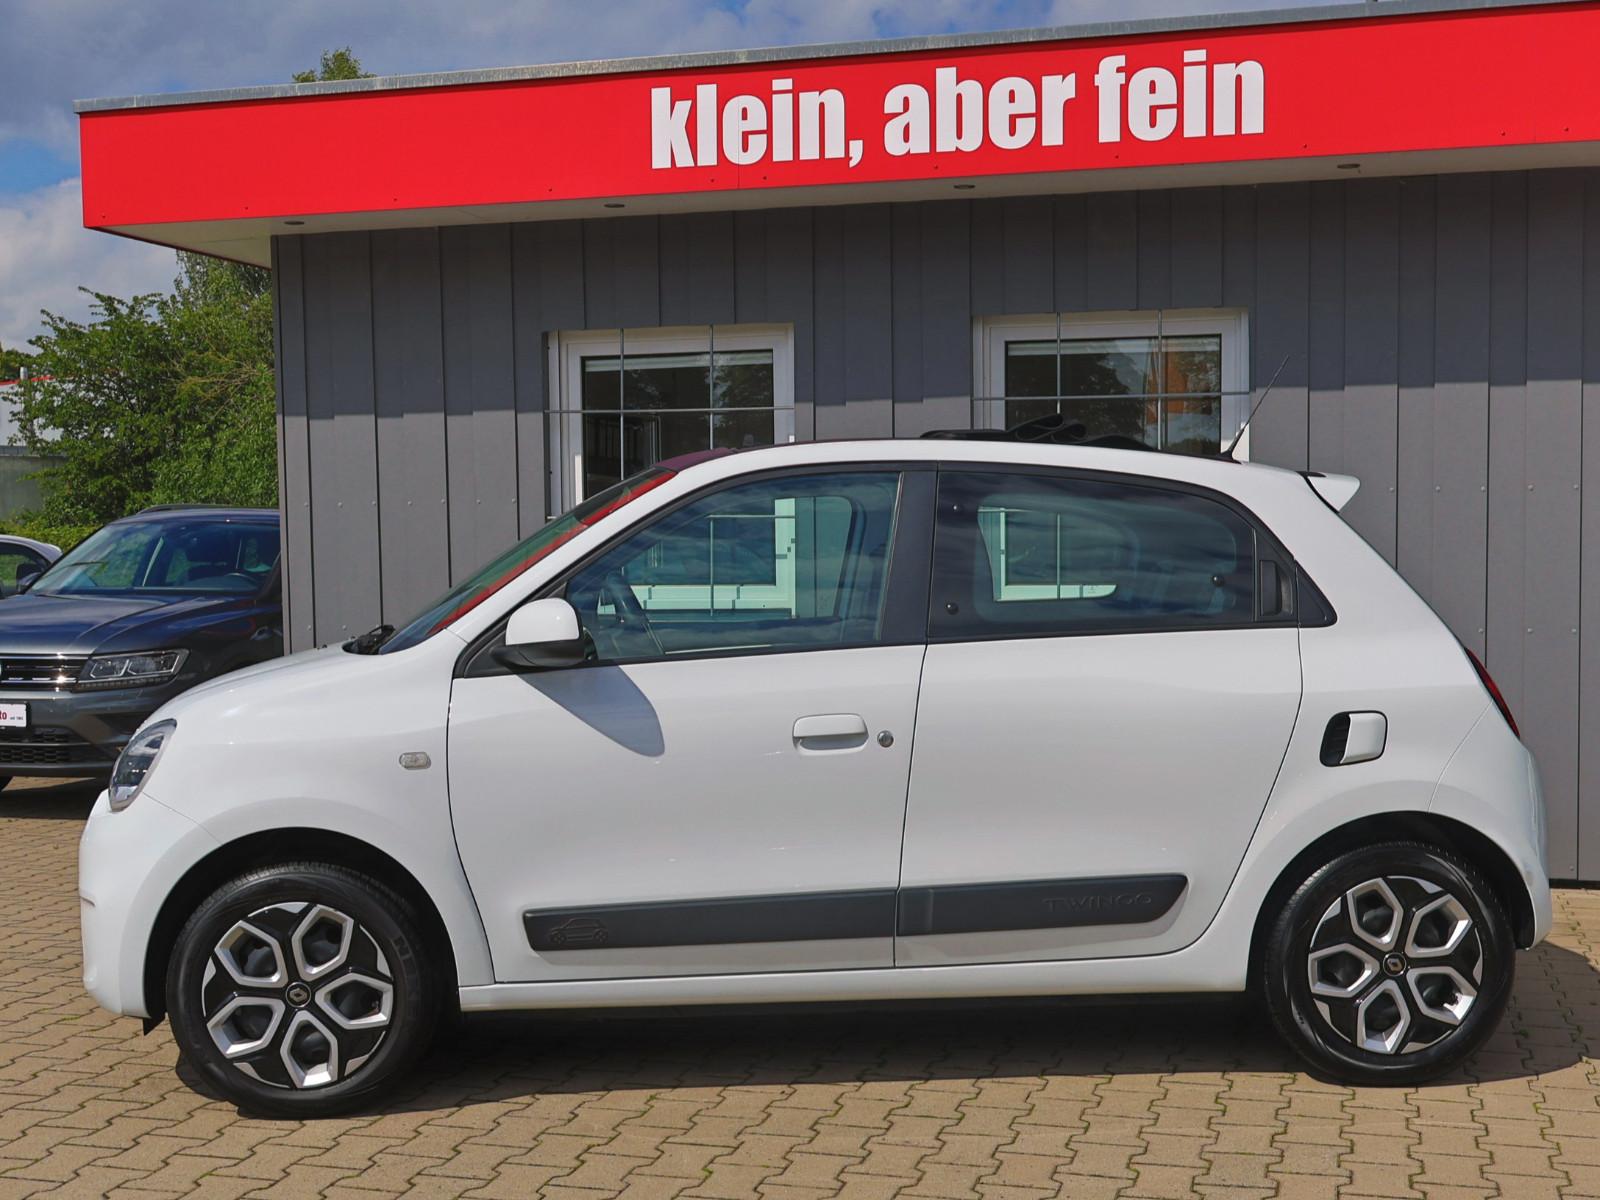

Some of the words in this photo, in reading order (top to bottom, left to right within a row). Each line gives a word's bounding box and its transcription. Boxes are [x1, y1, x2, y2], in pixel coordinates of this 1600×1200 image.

[651, 78, 864, 170] klein,
[883, 66, 1076, 156] aber
[1094, 49, 1265, 143] fein
[1042, 892, 1153, 912] TWINGO
